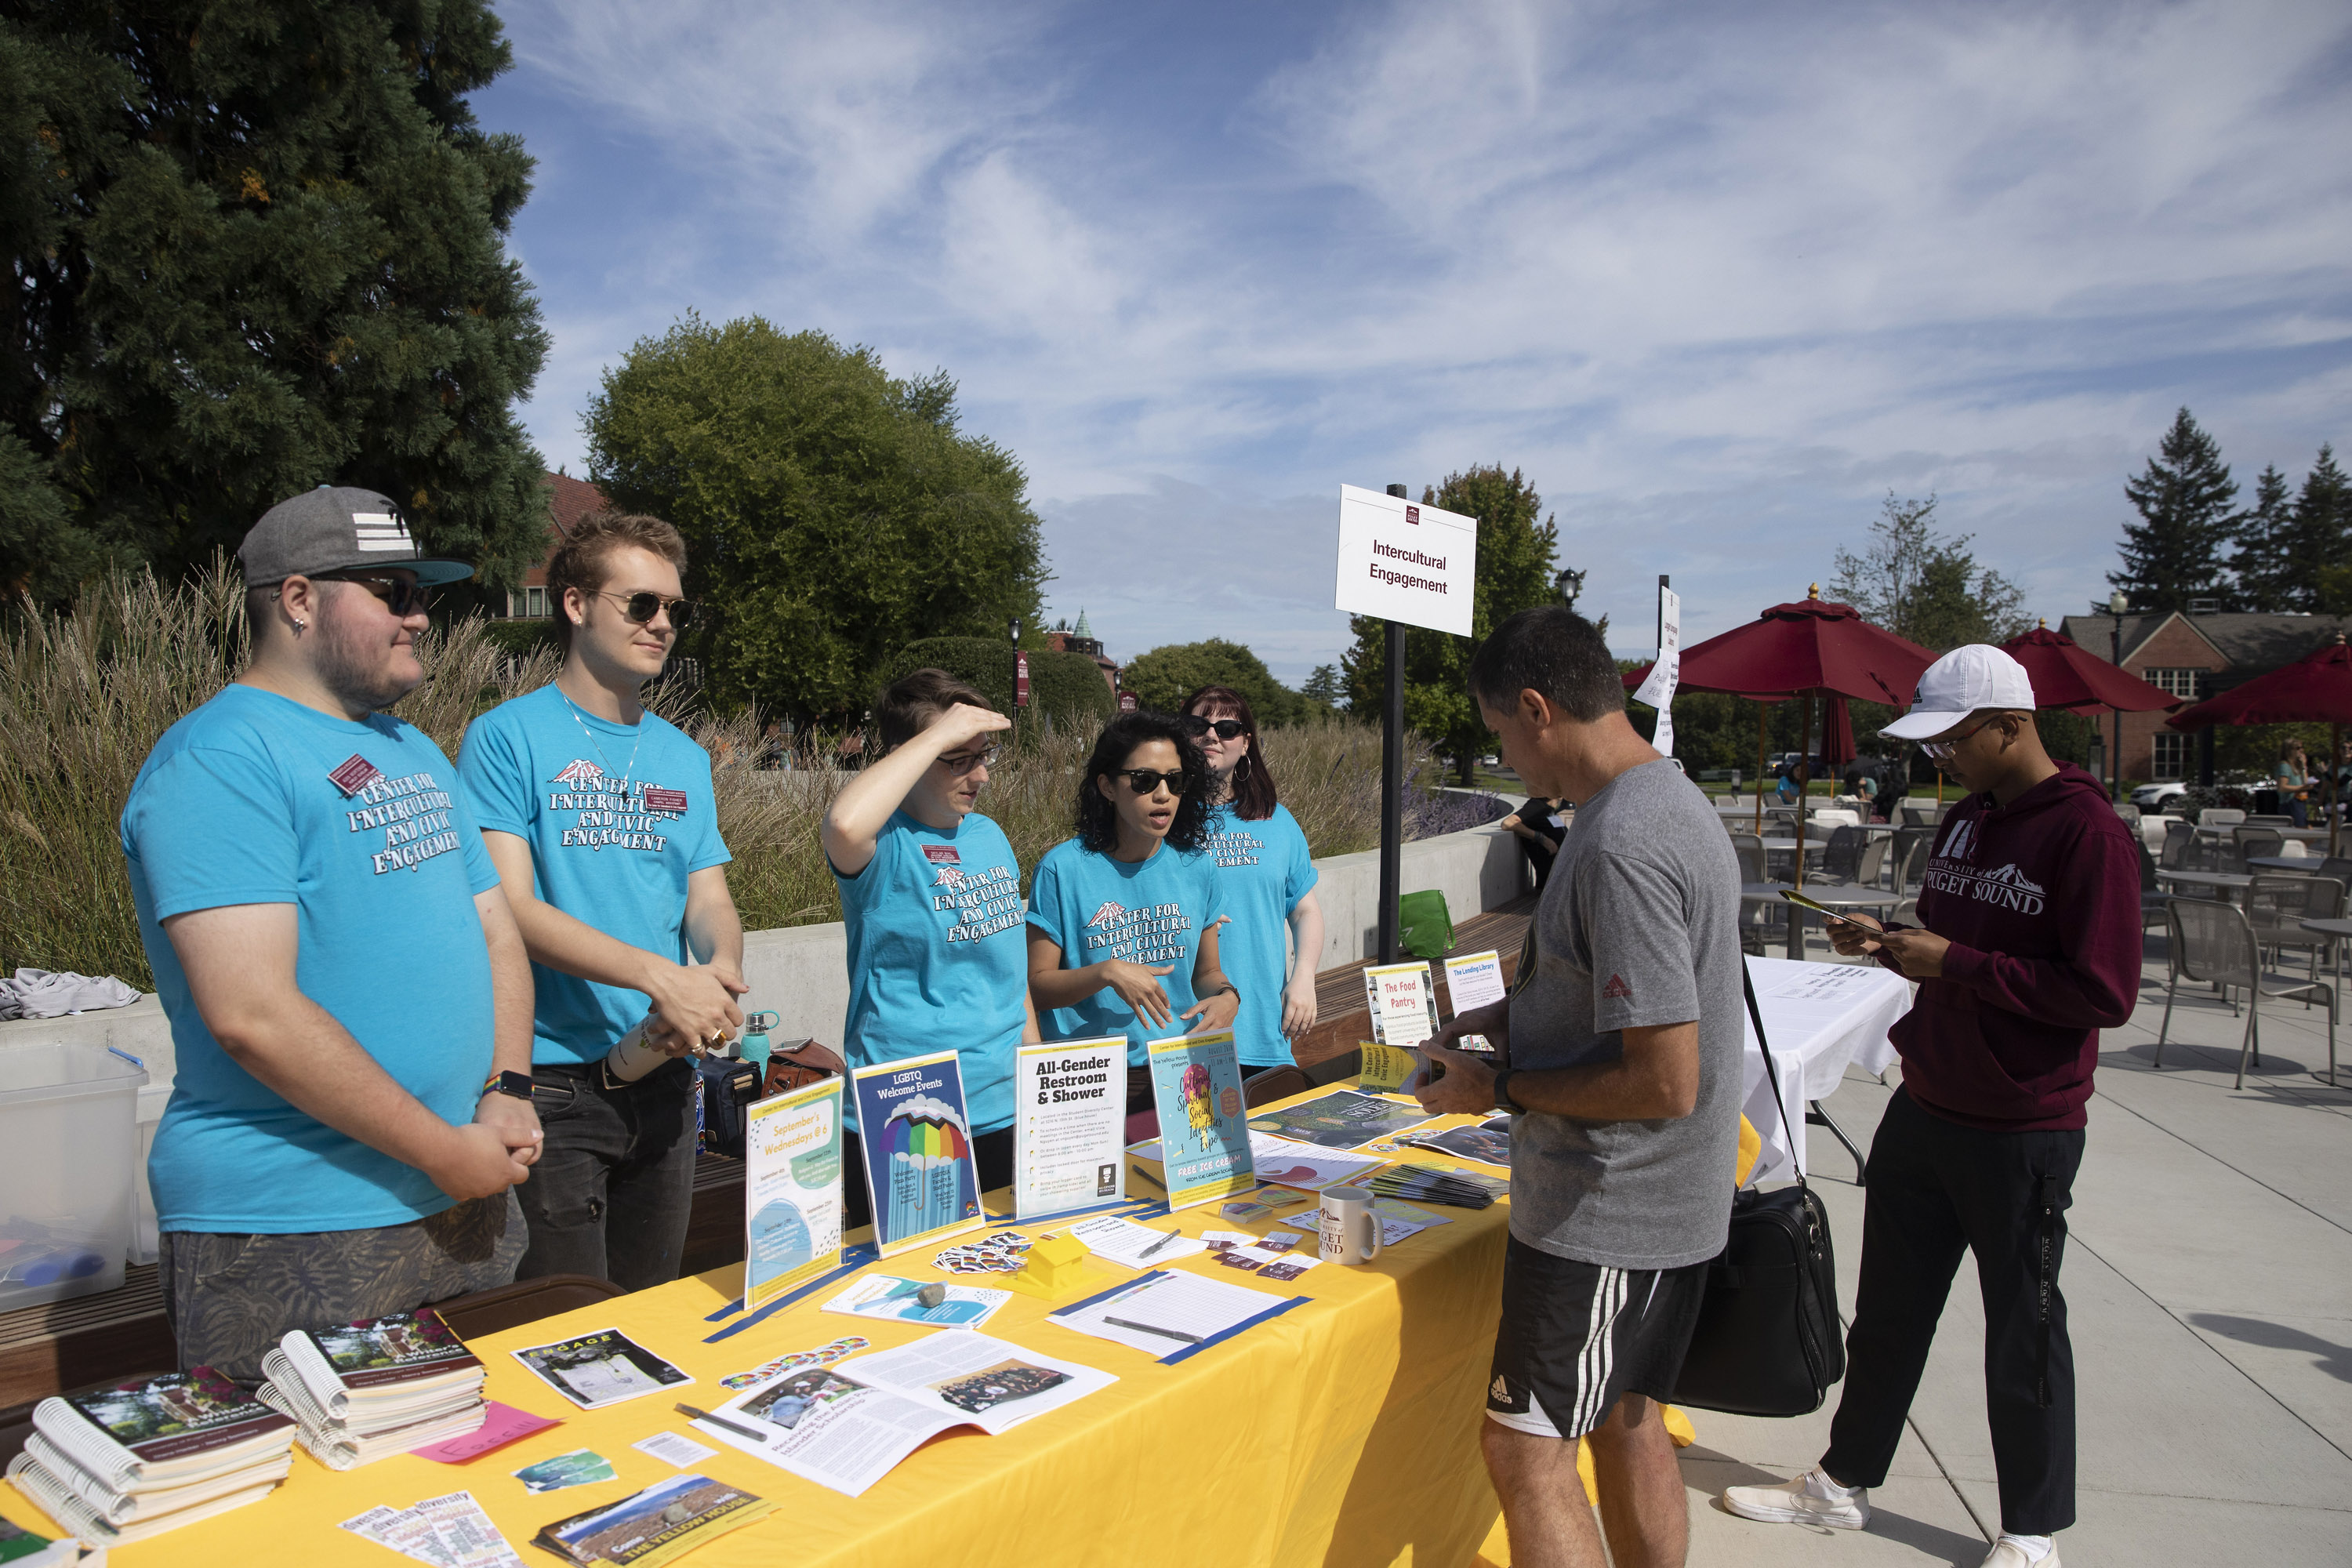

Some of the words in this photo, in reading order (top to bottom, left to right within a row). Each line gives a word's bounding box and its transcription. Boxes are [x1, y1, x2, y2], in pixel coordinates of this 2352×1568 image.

[1374, 539, 1446, 571] Intercultural
[1370, 563, 1448, 594] Engagement
[361, 776, 420, 806] CENTER
[414, 772, 438, 790] FOR
[347, 791, 453, 833] INTERCULTURAL
[573, 811, 613, 833] AND
[384, 820, 419, 856] AND
[1229, 832, 1253, 840] FOR
[1216, 848, 1249, 858] CIVIC
[989, 865, 1013, 881] FOR
[1929, 858, 1976, 876] UNIVERSITY
[1976, 869, 1985, 880] of
[1927, 870, 1970, 896] PUGET
[1972, 880, 2044, 916] SOUND
[956, 907, 985, 929] AND
[986, 895, 1018, 918] CIVIC
[1101, 907, 1152, 931] CENTER
[1155, 902, 1181, 917] FOR
[1087, 916, 1191, 949] INTERCULTURAL
[1110, 940, 1134, 960] AND
[1136, 932, 1176, 950] CIVIC
[1462, 966, 1479, 975] Lending
[1385, 982, 1397, 993] The
[1399, 979, 1416, 991] Food
[1390, 997, 1416, 1009] Pantry
[1208, 1046, 1223, 1054] AUGUST
[1036, 1056, 1111, 1076] All-Gender
[893, 1070, 923, 1085] LGBTQ
[1040, 1073, 1107, 1090] Restroom
[1179, 1065, 1212, 1093] Cultural
[779, 1099, 798, 1109] Intercultural
[811, 1087, 830, 1098] Engagement
[877, 1085, 916, 1100] Welcome
[916, 1078, 943, 1092] Events
[1037, 1091, 1048, 1105] &
[1052, 1087, 1105, 1103] Shower
[1178, 1087, 1211, 1114] Spiritual
[1189, 1102, 1213, 1123] Social
[773, 1112, 820, 1137] September's
[1189, 1117, 1223, 1140] Identities
[764, 1131, 813, 1156] Wednesdays
[814, 1126, 822, 1138] @
[822, 1123, 828, 1134] 6
[1200, 1135, 1218, 1152] Expo
[806, 1153, 823, 1163] September
[1178, 1165, 1197, 1177] FREE
[1200, 1161, 1214, 1171] ICE
[1215, 1154, 1242, 1167] CREAM
[895, 1169, 914, 1178] Welcome
[394, 1347, 464, 1364] Reference
[405, 1344, 460, 1357] Writer's
[528, 1334, 612, 1358] ENGAGE
[1490, 1388, 1512, 1404] adidas
[187, 1406, 266, 1428] Reference
[198, 1402, 259, 1419] Writer's
[771, 1421, 816, 1452] Receiving
[814, 1411, 830, 1424] the
[830, 1397, 855, 1411] Asian
[780, 1429, 816, 1456] Islander
[816, 1399, 866, 1430] Scholarship
[416, 1491, 470, 1509] diversity
[713, 1492, 739, 1504] with
[343, 1506, 394, 1530] diversity
[372, 1508, 425, 1531] diversity
[622, 1541, 654, 1559] THE
[652, 1517, 706, 1546] YELLOW
[704, 1496, 751, 1519] HOUSE
[610, 1535, 645, 1554] Come
